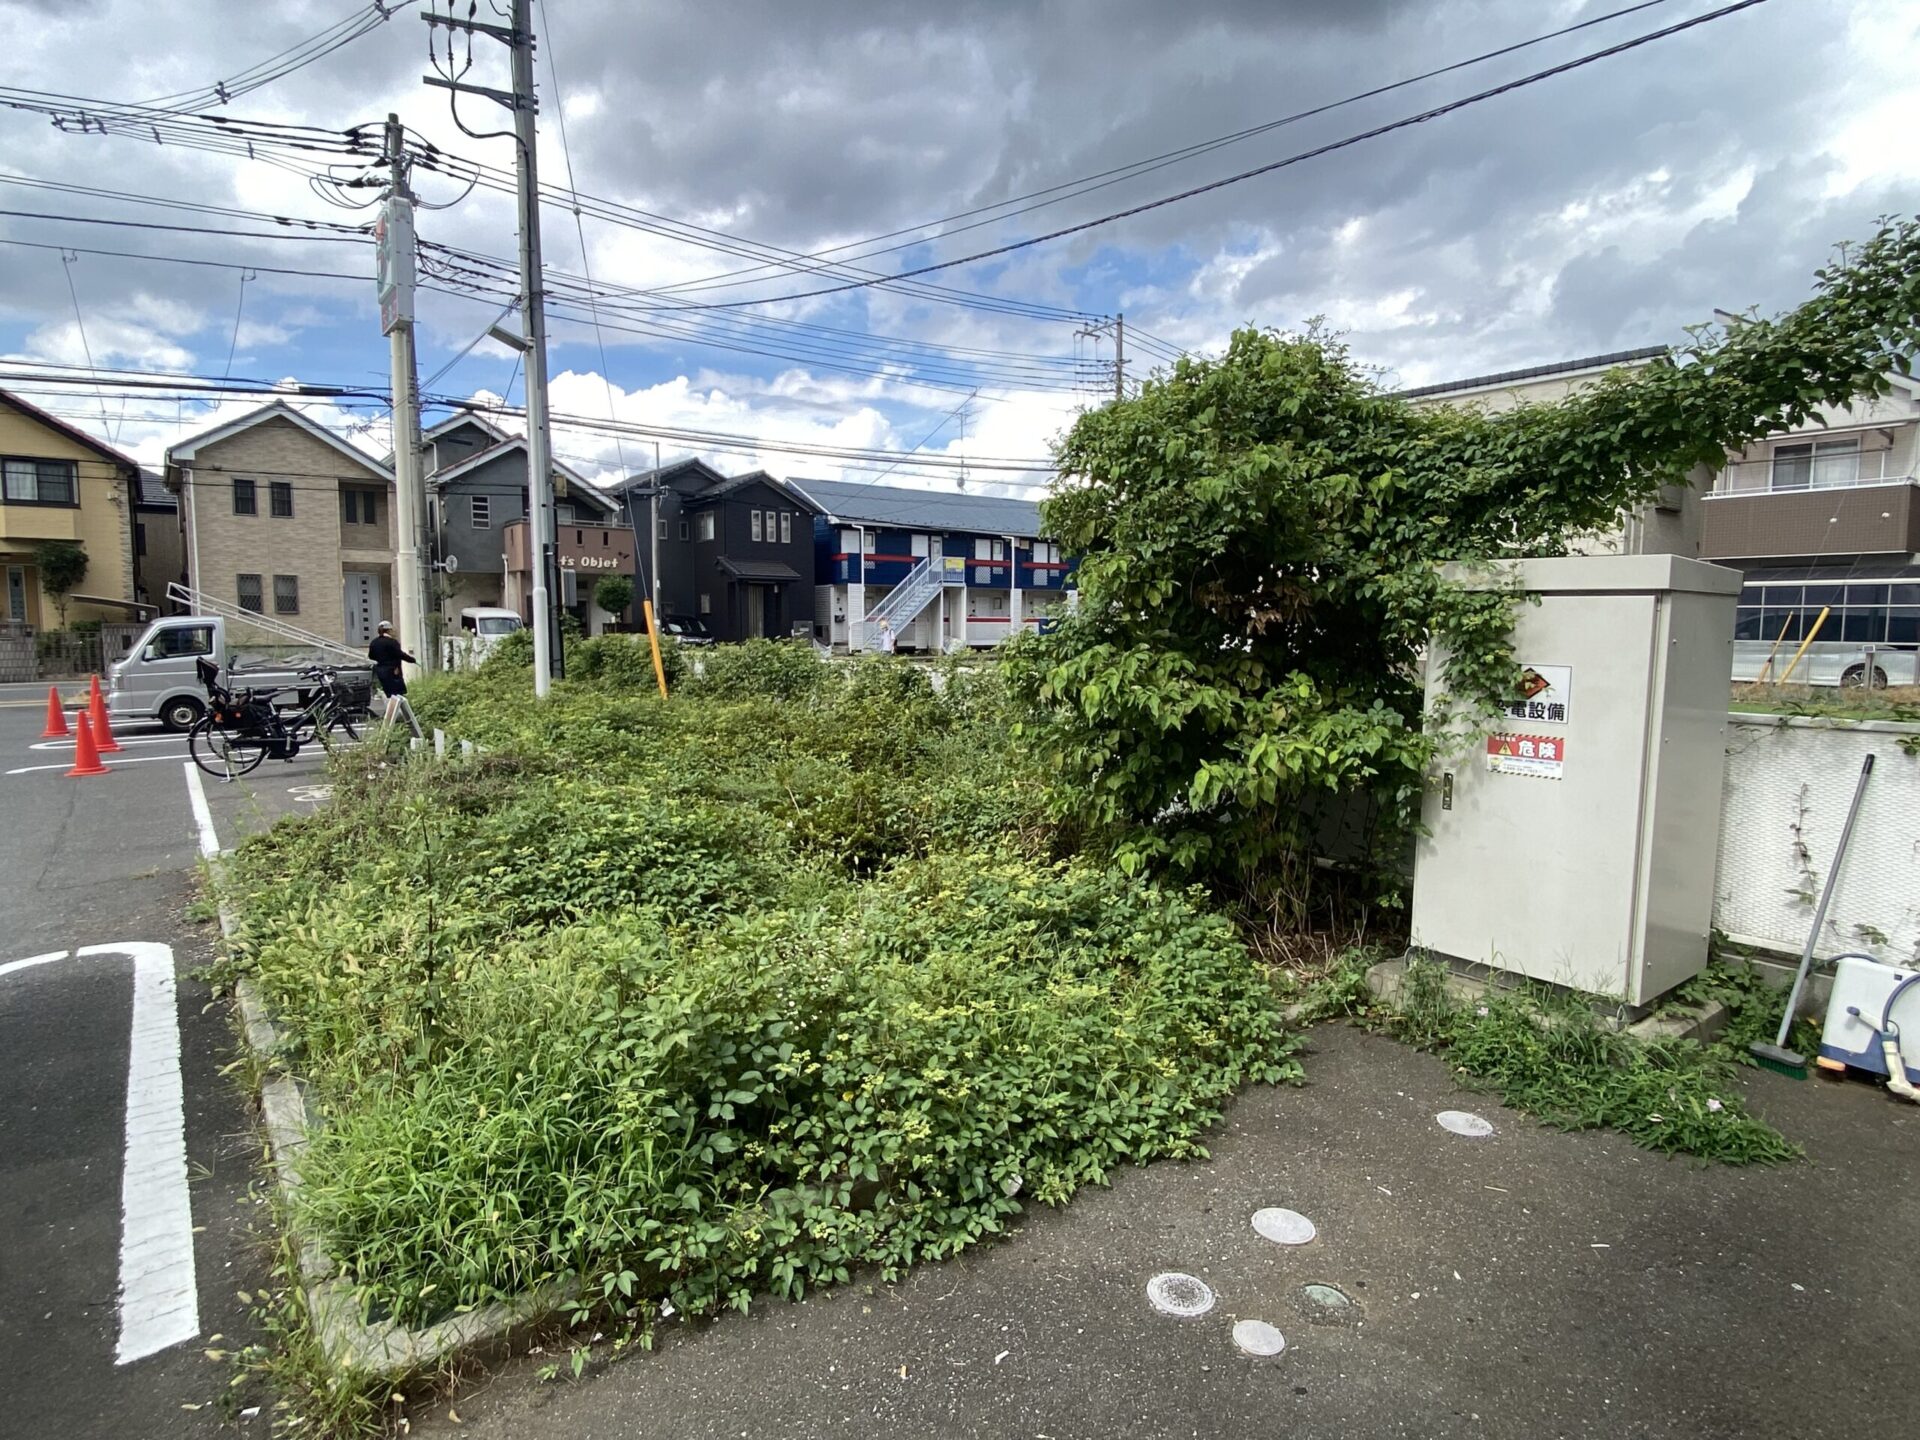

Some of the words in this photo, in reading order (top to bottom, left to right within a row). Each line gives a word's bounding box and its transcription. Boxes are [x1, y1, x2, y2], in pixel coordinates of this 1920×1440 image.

[558, 555, 575, 566] t's
[580, 556, 618, 568] Objet
[1518, 740, 1556, 759] 危険
